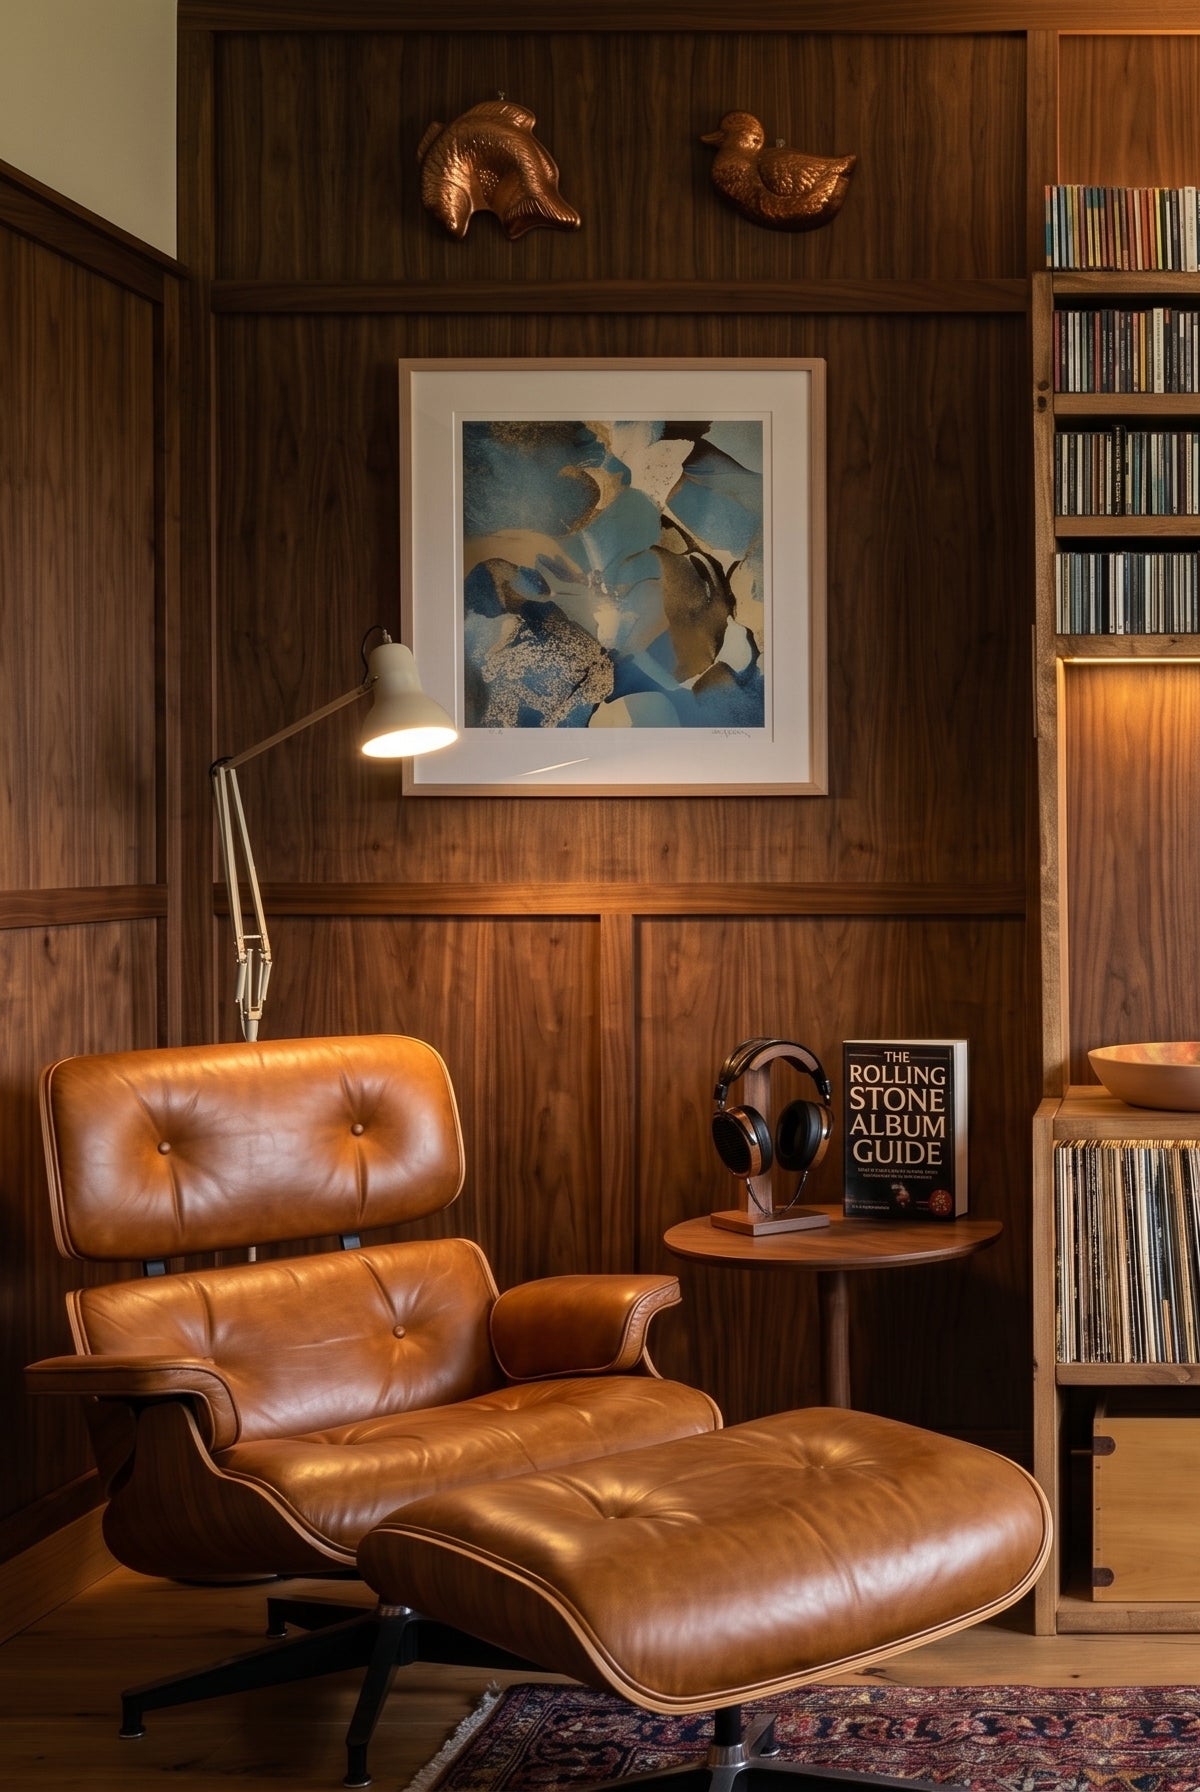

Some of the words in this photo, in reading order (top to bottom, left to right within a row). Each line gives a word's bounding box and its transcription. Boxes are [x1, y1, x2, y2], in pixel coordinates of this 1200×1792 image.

[884, 1051, 910, 1063] THE
[849, 1064, 946, 1085] ROLLING
[850, 1086, 946, 1112] STONE
[849, 1113, 946, 1138] ALBUM
[853, 1139, 942, 1165] GUIDE
